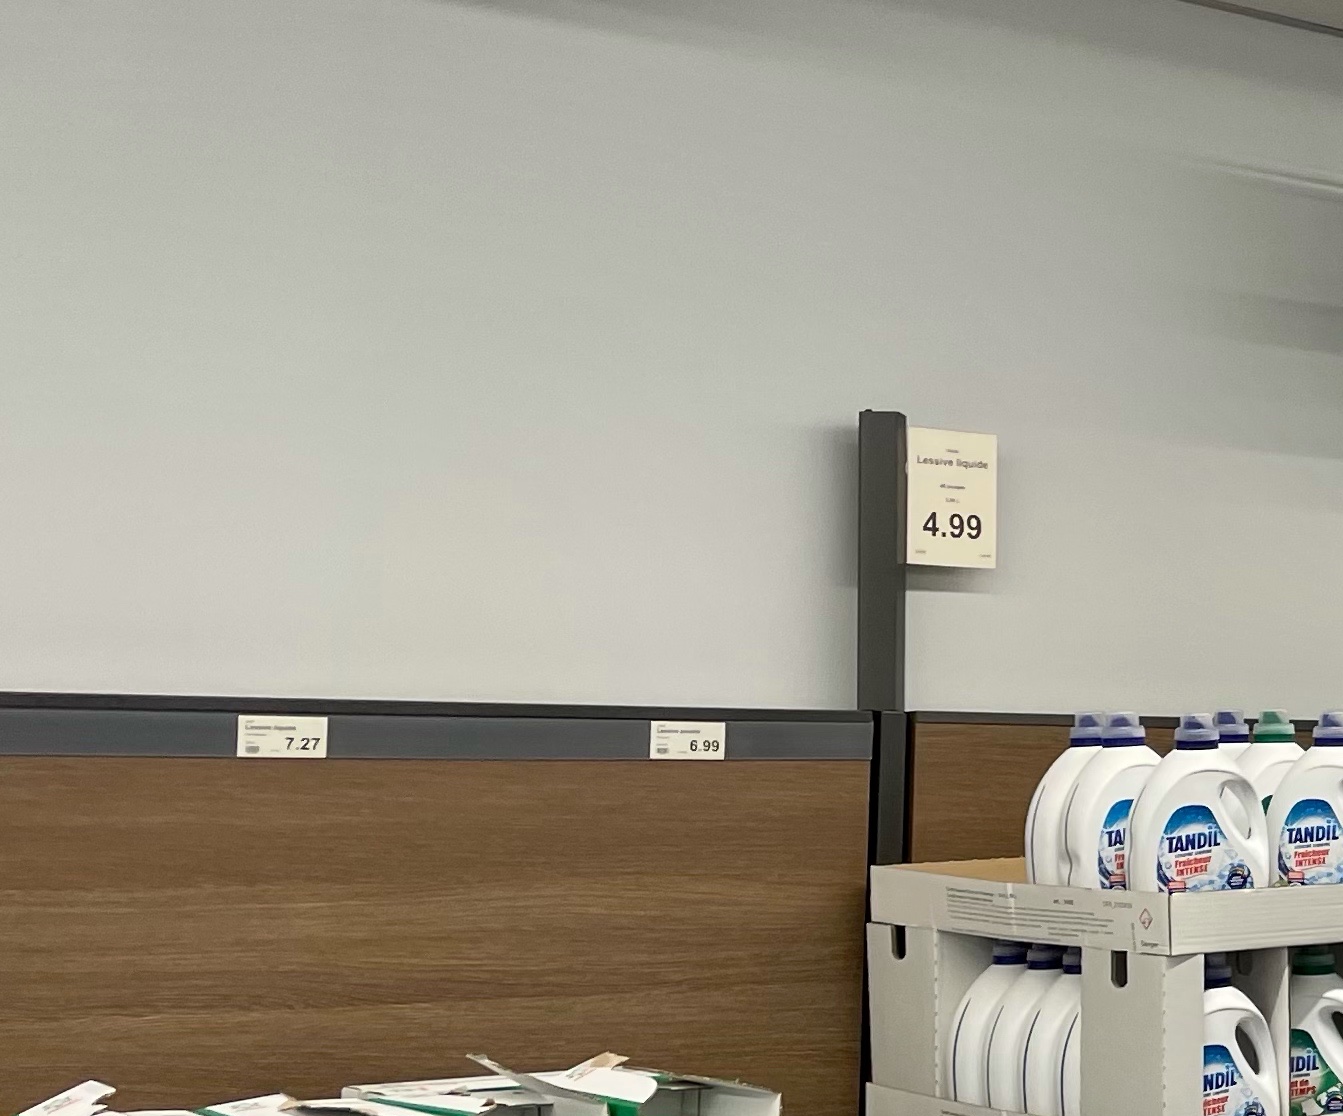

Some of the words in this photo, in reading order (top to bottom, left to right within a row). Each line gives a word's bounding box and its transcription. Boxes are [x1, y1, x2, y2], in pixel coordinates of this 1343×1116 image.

[916, 455, 954, 467] Lessive
[956, 458, 989, 470] liquide
[922, 511, 982, 539] 4.99
[284, 736, 321, 751] 7.27
[689, 739, 720, 753] 6.99
[1166, 823, 1221, 854] TANDIL
[1286, 818, 1340, 844] TANDIL
[1203, 1063, 1238, 1093] NDIL
